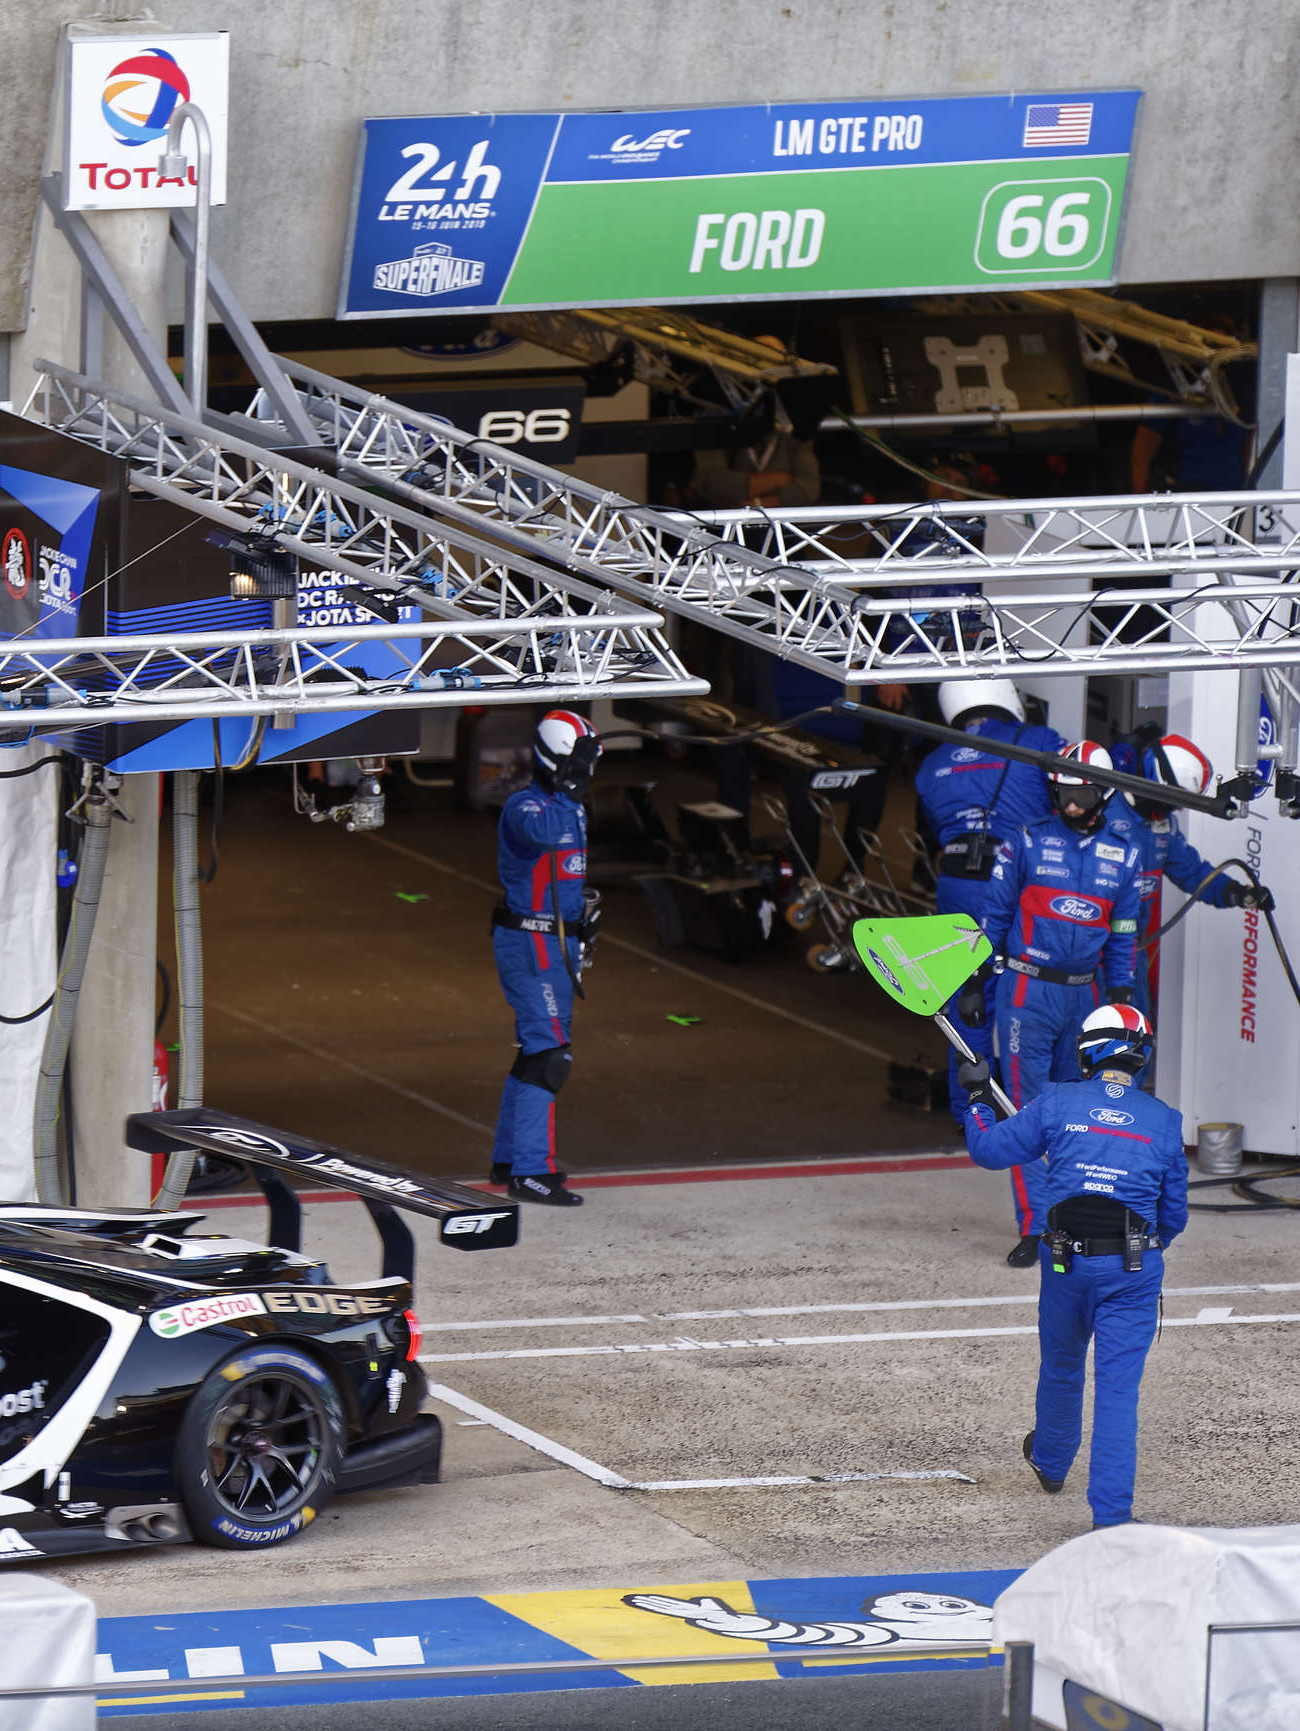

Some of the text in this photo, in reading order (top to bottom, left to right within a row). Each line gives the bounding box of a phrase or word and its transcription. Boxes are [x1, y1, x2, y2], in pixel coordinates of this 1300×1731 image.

[773, 114, 924, 157] LM GTE PRO
[384, 140, 502, 202] 24h
[378, 202, 492, 221] LE MANS
[995, 192, 1090, 260] 66
[688, 207, 826, 274] FORD
[375, 257, 482, 294] SUPERFINALE
[479, 408, 572, 445] 66
[1061, 898, 1095, 920] Ford
[1240, 904, 1260, 1044] RFORMANCE
[1065, 1124, 1089, 1133] FORD
[1097, 1109, 1126, 1124] Ford
[442, 1212, 513, 1235] GT
[180, 1292, 396, 1329] Castrol EDGE
[218, 1518, 291, 1543] MICHELIN
